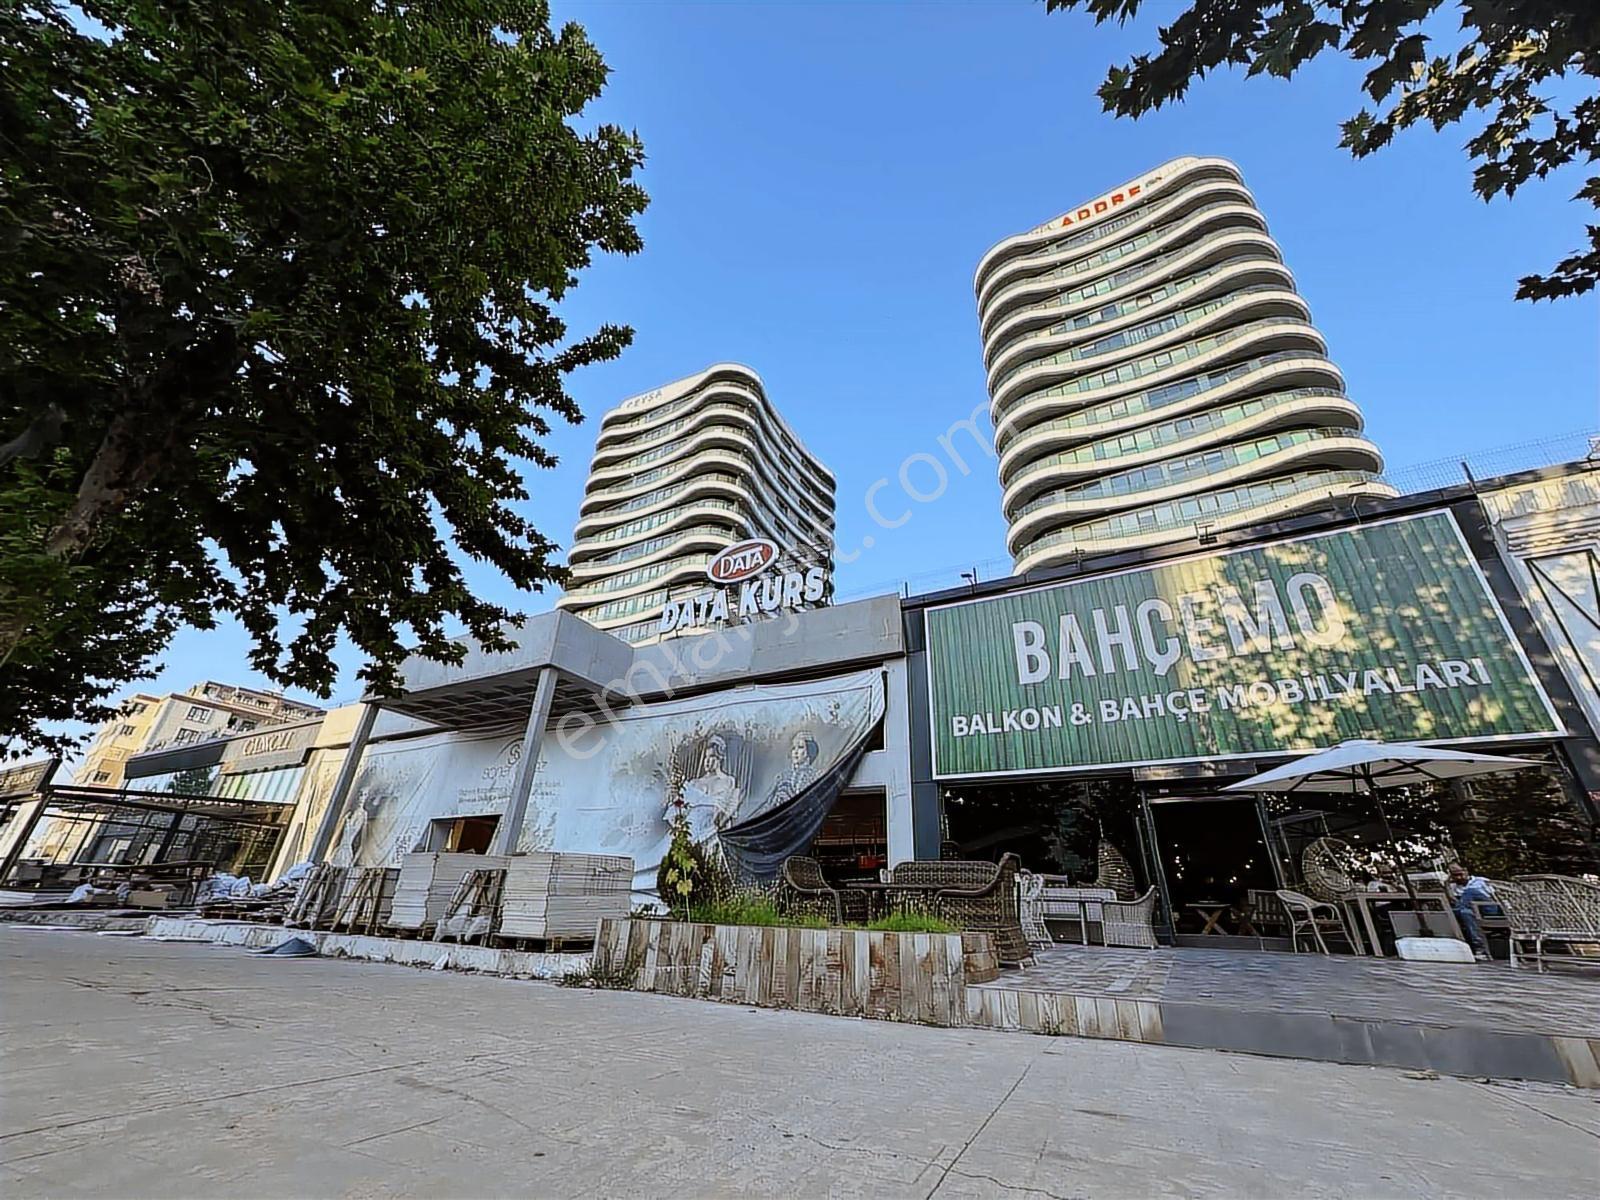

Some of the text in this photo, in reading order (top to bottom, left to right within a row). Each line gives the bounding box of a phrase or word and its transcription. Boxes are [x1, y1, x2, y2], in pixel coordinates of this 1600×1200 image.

[719, 545, 765, 578] DATA
[659, 566, 825, 634] DATA KURS
[1011, 571, 1348, 686] BAHÇEMO
[951, 656, 1493, 739] BALKON & BAHÇE MOBİLYALARI
